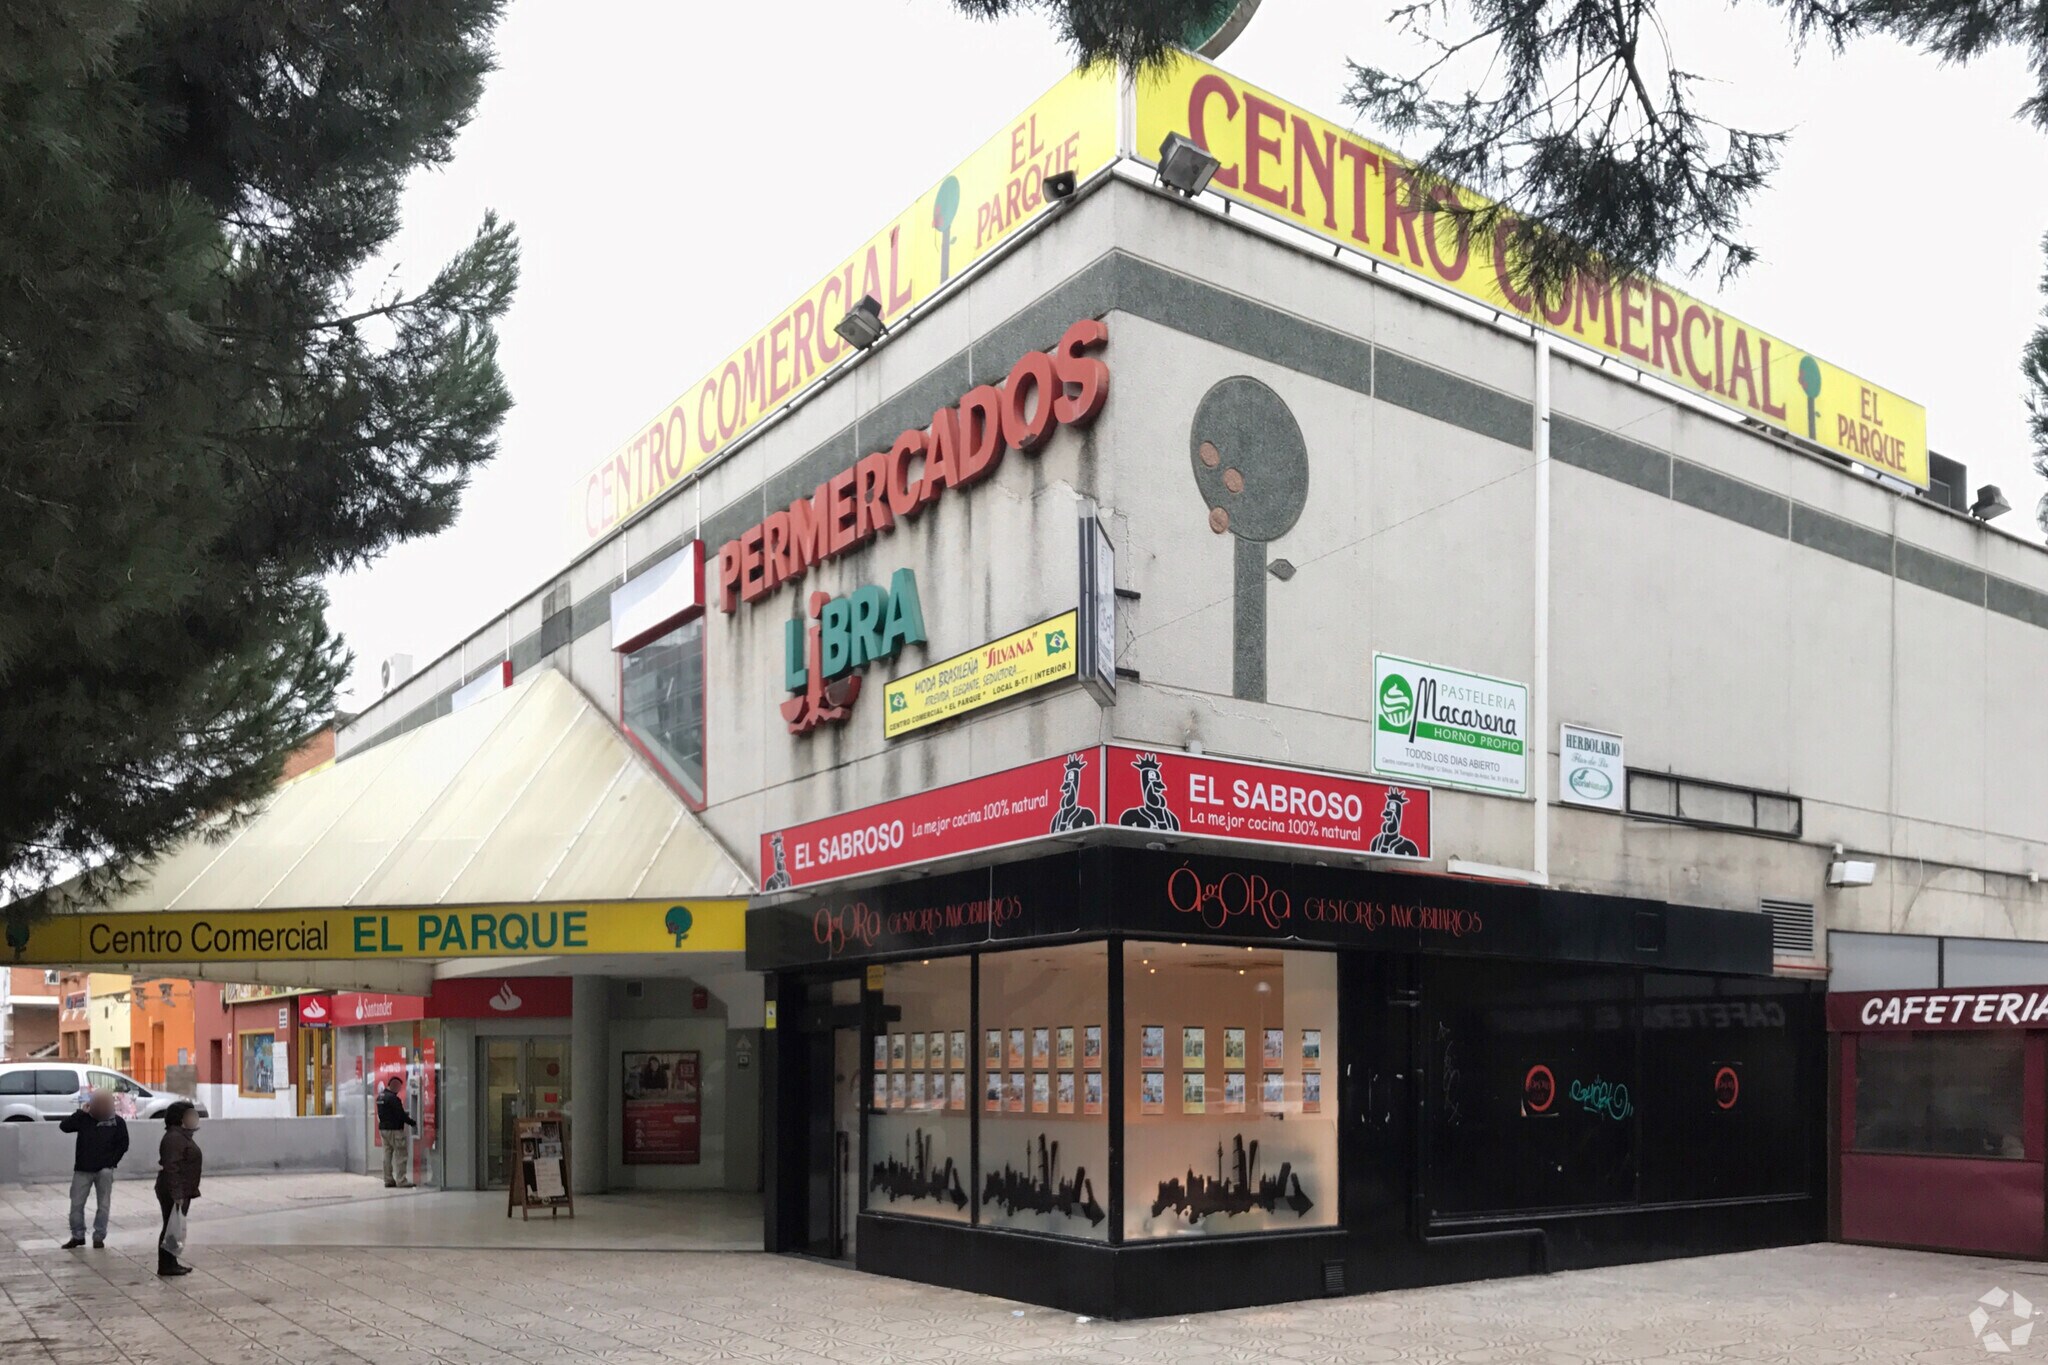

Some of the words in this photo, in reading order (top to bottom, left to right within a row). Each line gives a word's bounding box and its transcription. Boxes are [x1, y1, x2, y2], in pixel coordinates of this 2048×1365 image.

[1010, 112, 1044, 174] EL
[976, 130, 1080, 250] PARQUE
[1188, 74, 1469, 281] CENTRO
[585, 405, 686, 538] CENTRO
[698, 224, 912, 453] COMERCIAL
[1861, 386, 1883, 426] EL
[1837, 413, 1907, 473] PARQUE
[720, 319, 1110, 613] PERMERCADOS
[914, 677, 936, 696] MODA
[938, 657, 979, 688] BRASILEÑA
[1441, 684, 1516, 711] PASTELERIA
[889, 718, 911, 731] CENTRO
[912, 708, 943, 724] COMERCIAL
[992, 683, 1013, 696] LOCAL
[1408, 677, 1517, 743] Macarena
[1405, 747, 1432, 761] TODOS
[1433, 753, 1450, 764] LOS
[1450, 756, 1468, 767] DIAS
[1469, 758, 1500, 772] ABIERTO
[1434, 727, 1476, 744] HORNO
[1480, 736, 1520, 752] PROPIO
[1565, 734, 1620, 757] HERBOLARIO
[1189, 773, 1224, 805] EL
[1232, 779, 1362, 822] SABROSO
[794, 843, 815, 870] EL
[818, 819, 904, 865] SABROSO
[912, 821, 924, 838] La
[924, 818, 952, 837] mejor
[952, 810, 982, 832] cocina
[983, 800, 1010, 822] 100%
[1011, 789, 1048, 815] natural
[1189, 807, 1205, 824] La
[1208, 812, 1245, 832] mejor
[1248, 816, 1285, 834] cocina
[1288, 818, 1319, 837] 100%
[1321, 825, 1361, 842] natural
[89, 923, 183, 954] Centro
[191, 920, 328, 952] Comercial
[353, 916, 403, 952] EL
[418, 911, 588, 951] PARQUE
[1304, 897, 1385, 931] GESTORES
[363, 995, 393, 1018] Santander
[1861, 992, 2048, 1026] CAFETERIA
